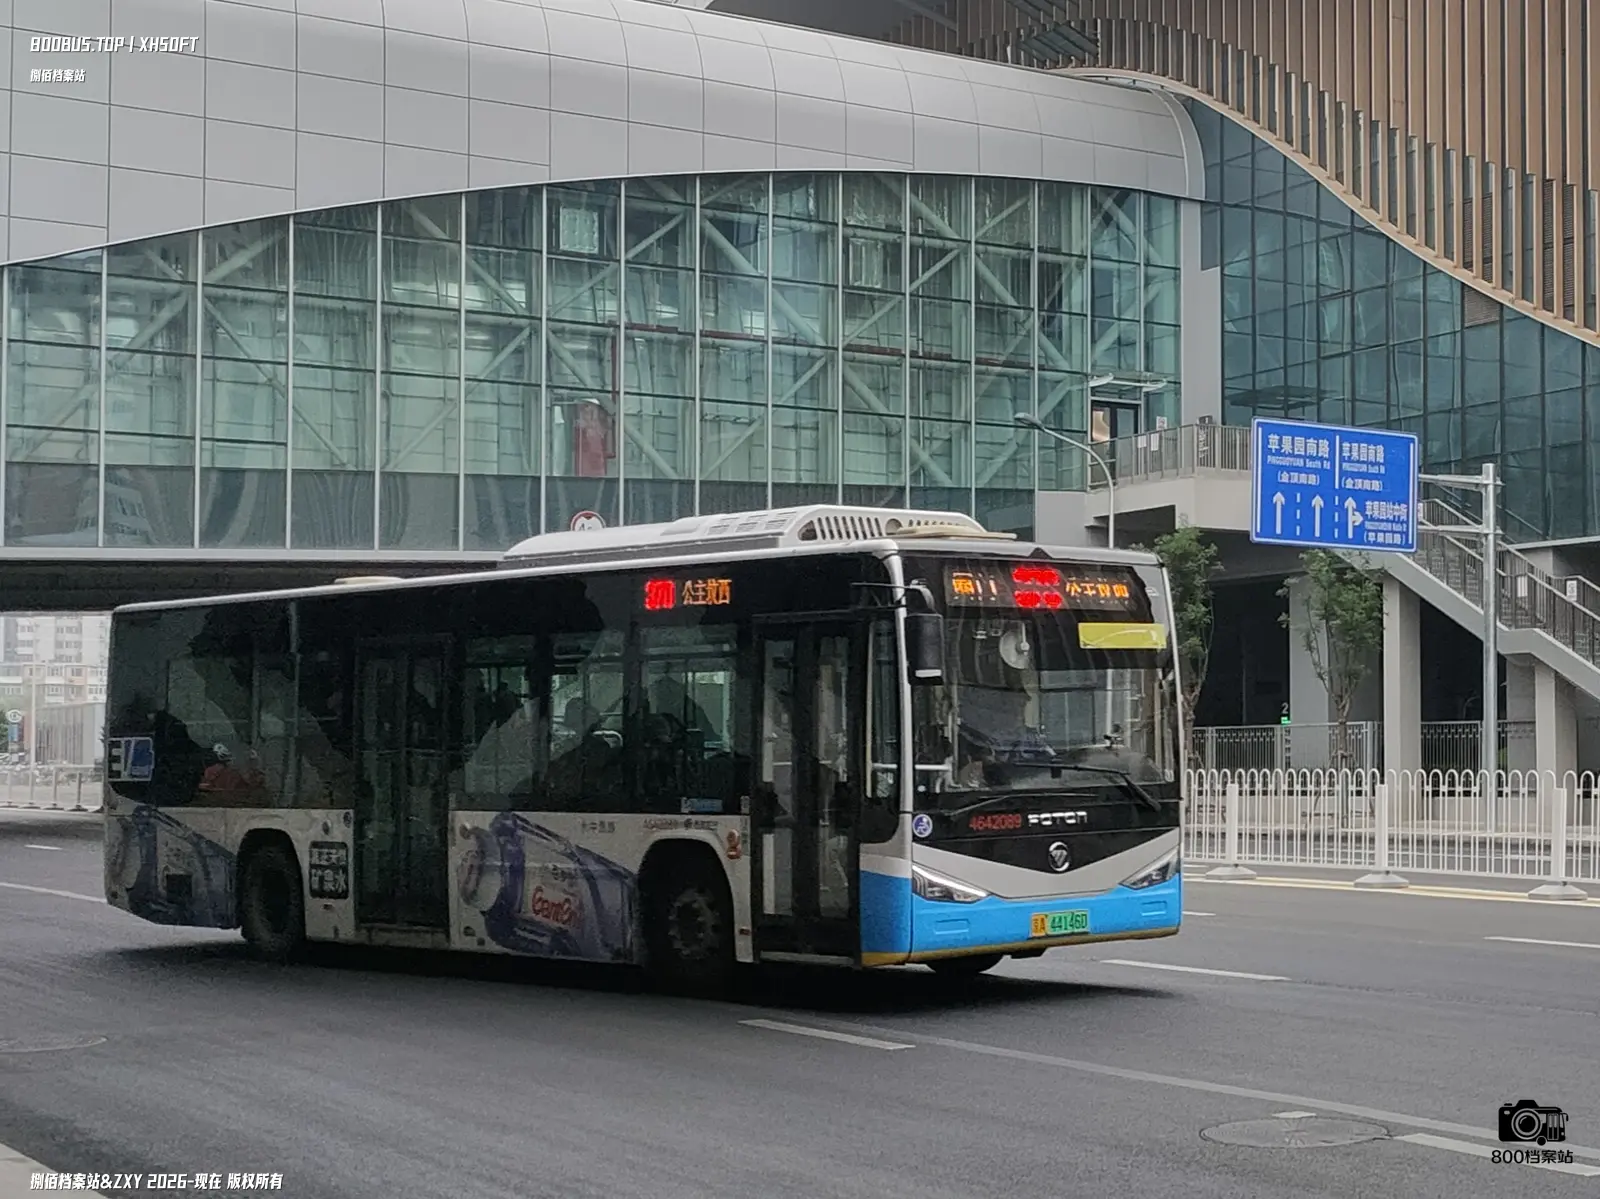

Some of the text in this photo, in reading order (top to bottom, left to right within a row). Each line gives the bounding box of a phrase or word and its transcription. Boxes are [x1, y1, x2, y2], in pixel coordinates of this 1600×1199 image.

[1267, 433, 1330, 458] 苹果园南路
[1281, 702, 1289, 714] 2
